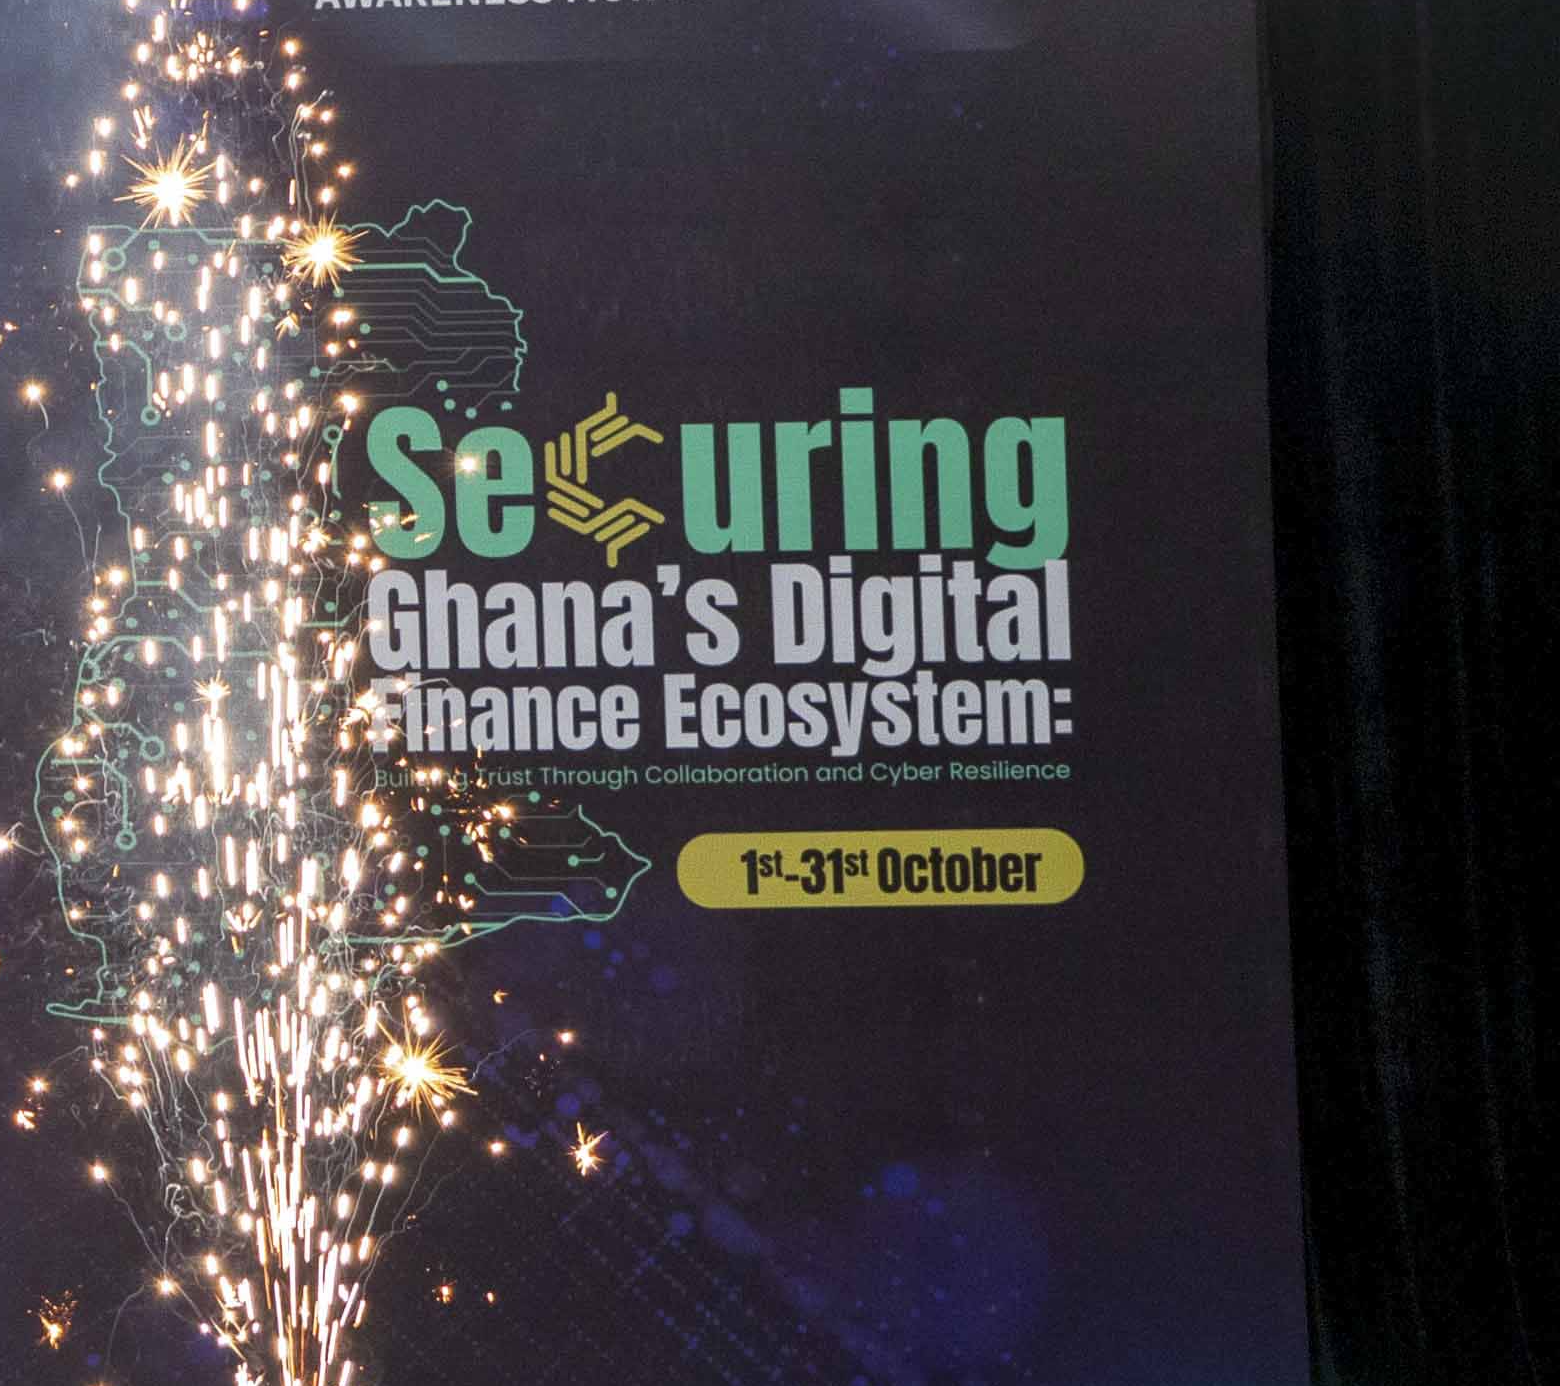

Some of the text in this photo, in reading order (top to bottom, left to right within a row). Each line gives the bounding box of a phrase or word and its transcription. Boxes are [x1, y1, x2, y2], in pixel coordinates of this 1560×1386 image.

[773, 554, 1072, 679] Digital
[370, 669, 1073, 758] Finance Ecosystem:
[475, 767, 532, 787] Trust
[540, 765, 638, 790] Through
[645, 763, 809, 785] Collaboration
[816, 762, 863, 782] and
[870, 762, 943, 787] Cyber
[950, 760, 1071, 782] Resilience
[877, 846, 1043, 894] October
